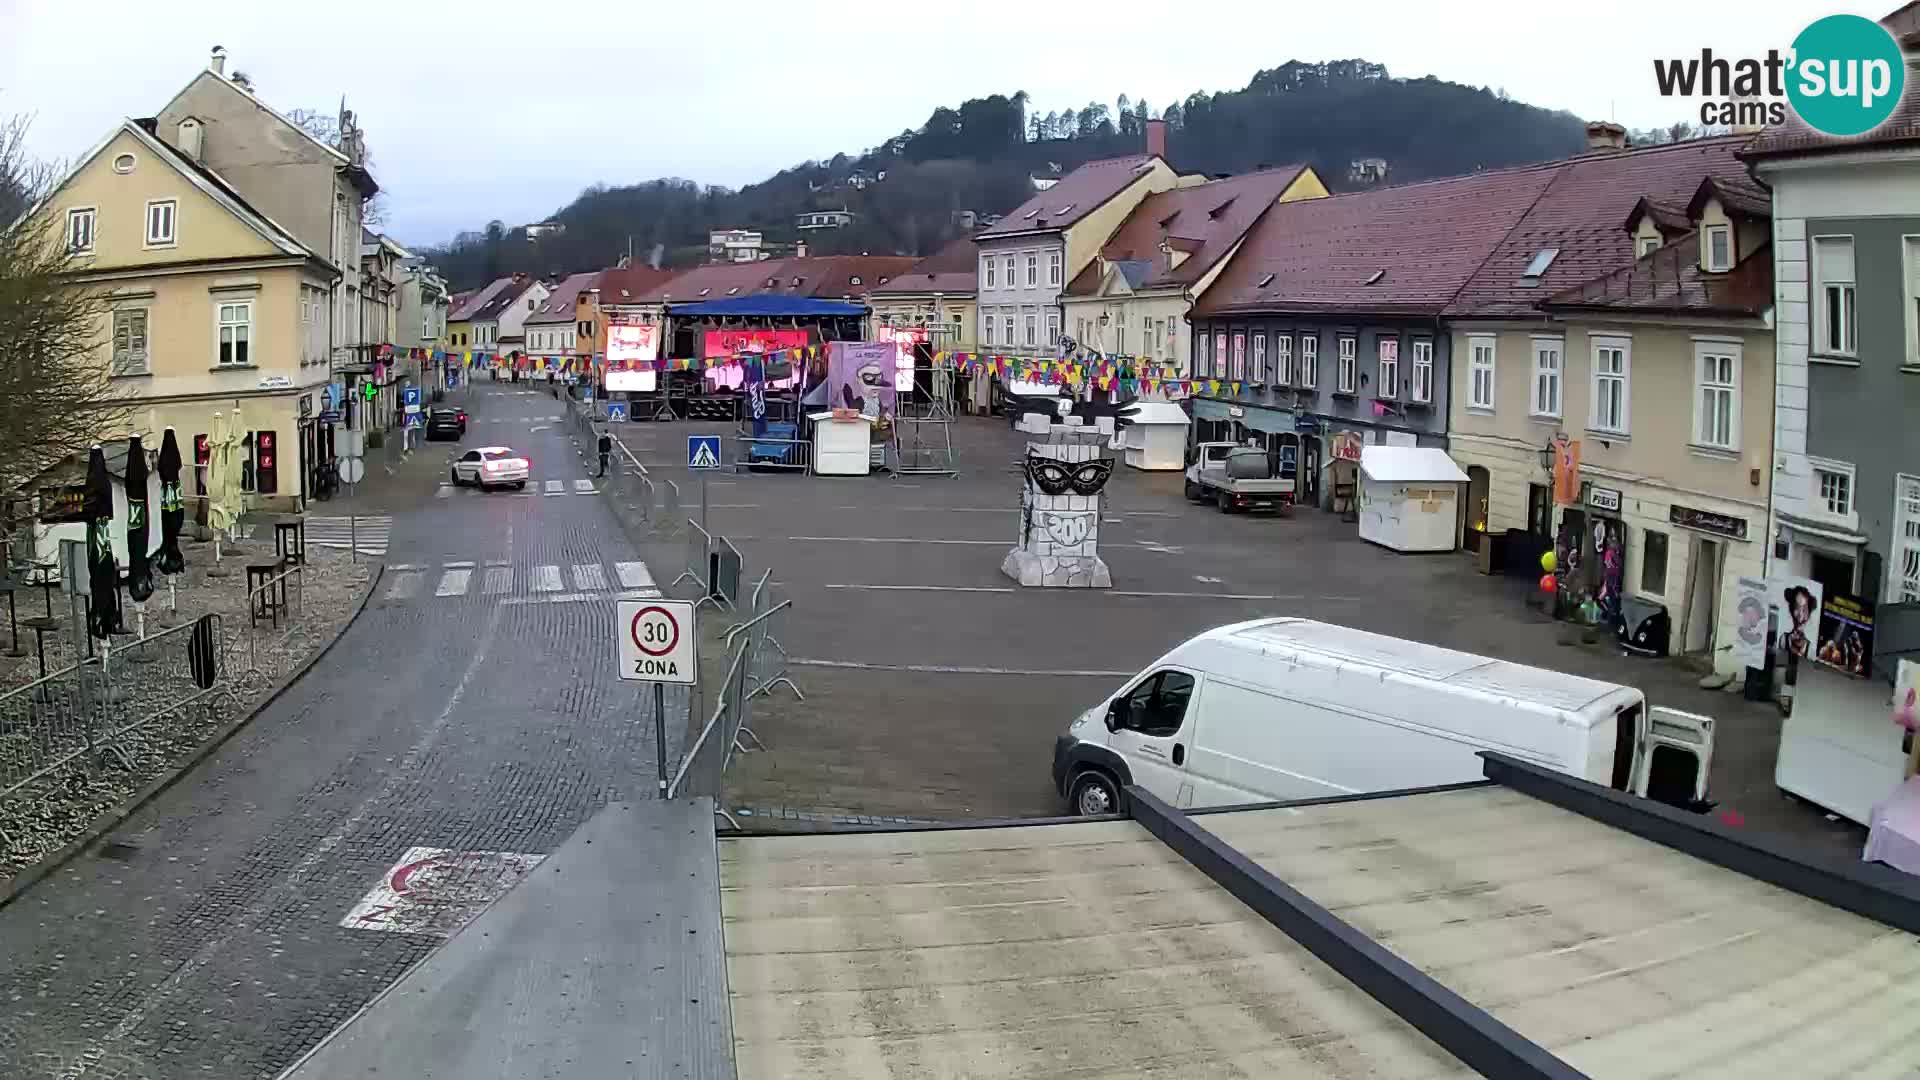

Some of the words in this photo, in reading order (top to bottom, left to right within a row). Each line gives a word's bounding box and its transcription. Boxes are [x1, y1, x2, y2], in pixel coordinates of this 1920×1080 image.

[408, 391, 416, 403] P
[643, 622, 668, 643] 30
[634, 659, 678, 676] ZONA
